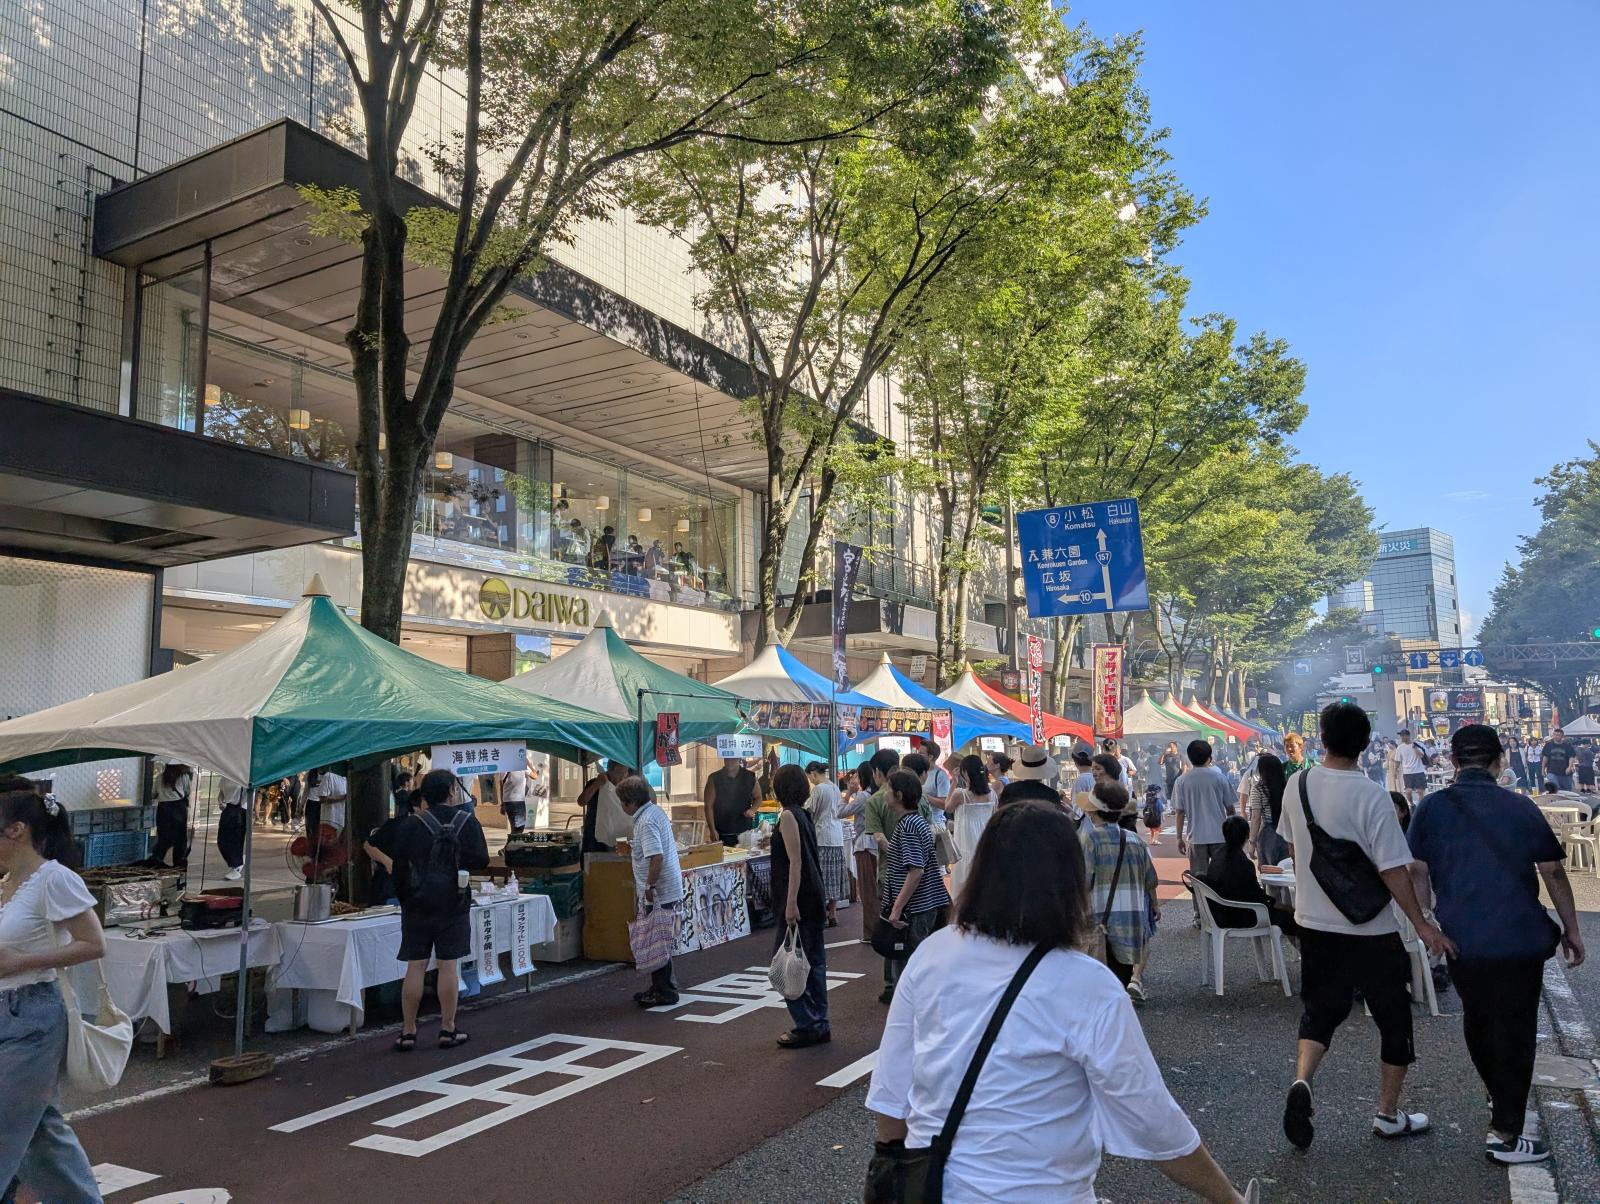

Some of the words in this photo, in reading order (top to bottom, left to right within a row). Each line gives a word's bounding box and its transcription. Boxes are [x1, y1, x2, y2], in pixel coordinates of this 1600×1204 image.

[1064, 507, 1094, 522] 小松
[1107, 503, 1132, 517] 白山
[1049, 515, 1056, 525] 8
[1064, 521, 1096, 531] Komatsu
[1108, 516, 1133, 526] Hakusan
[1041, 545, 1081, 562] 兼六園
[1098, 552, 1110, 562] 157
[1037, 560, 1067, 570] Kenrokuen
[1067, 557, 1088, 567] Garden
[1042, 570, 1072, 584] 広坂
[1045, 584, 1070, 592] Hirosaka
[1080, 593, 1091, 602] 10
[513, 587, 590, 627] Daiwa
[1103, 651, 1117, 728] フライドポテト
[452, 748, 500, 764] 海鮮焼き
